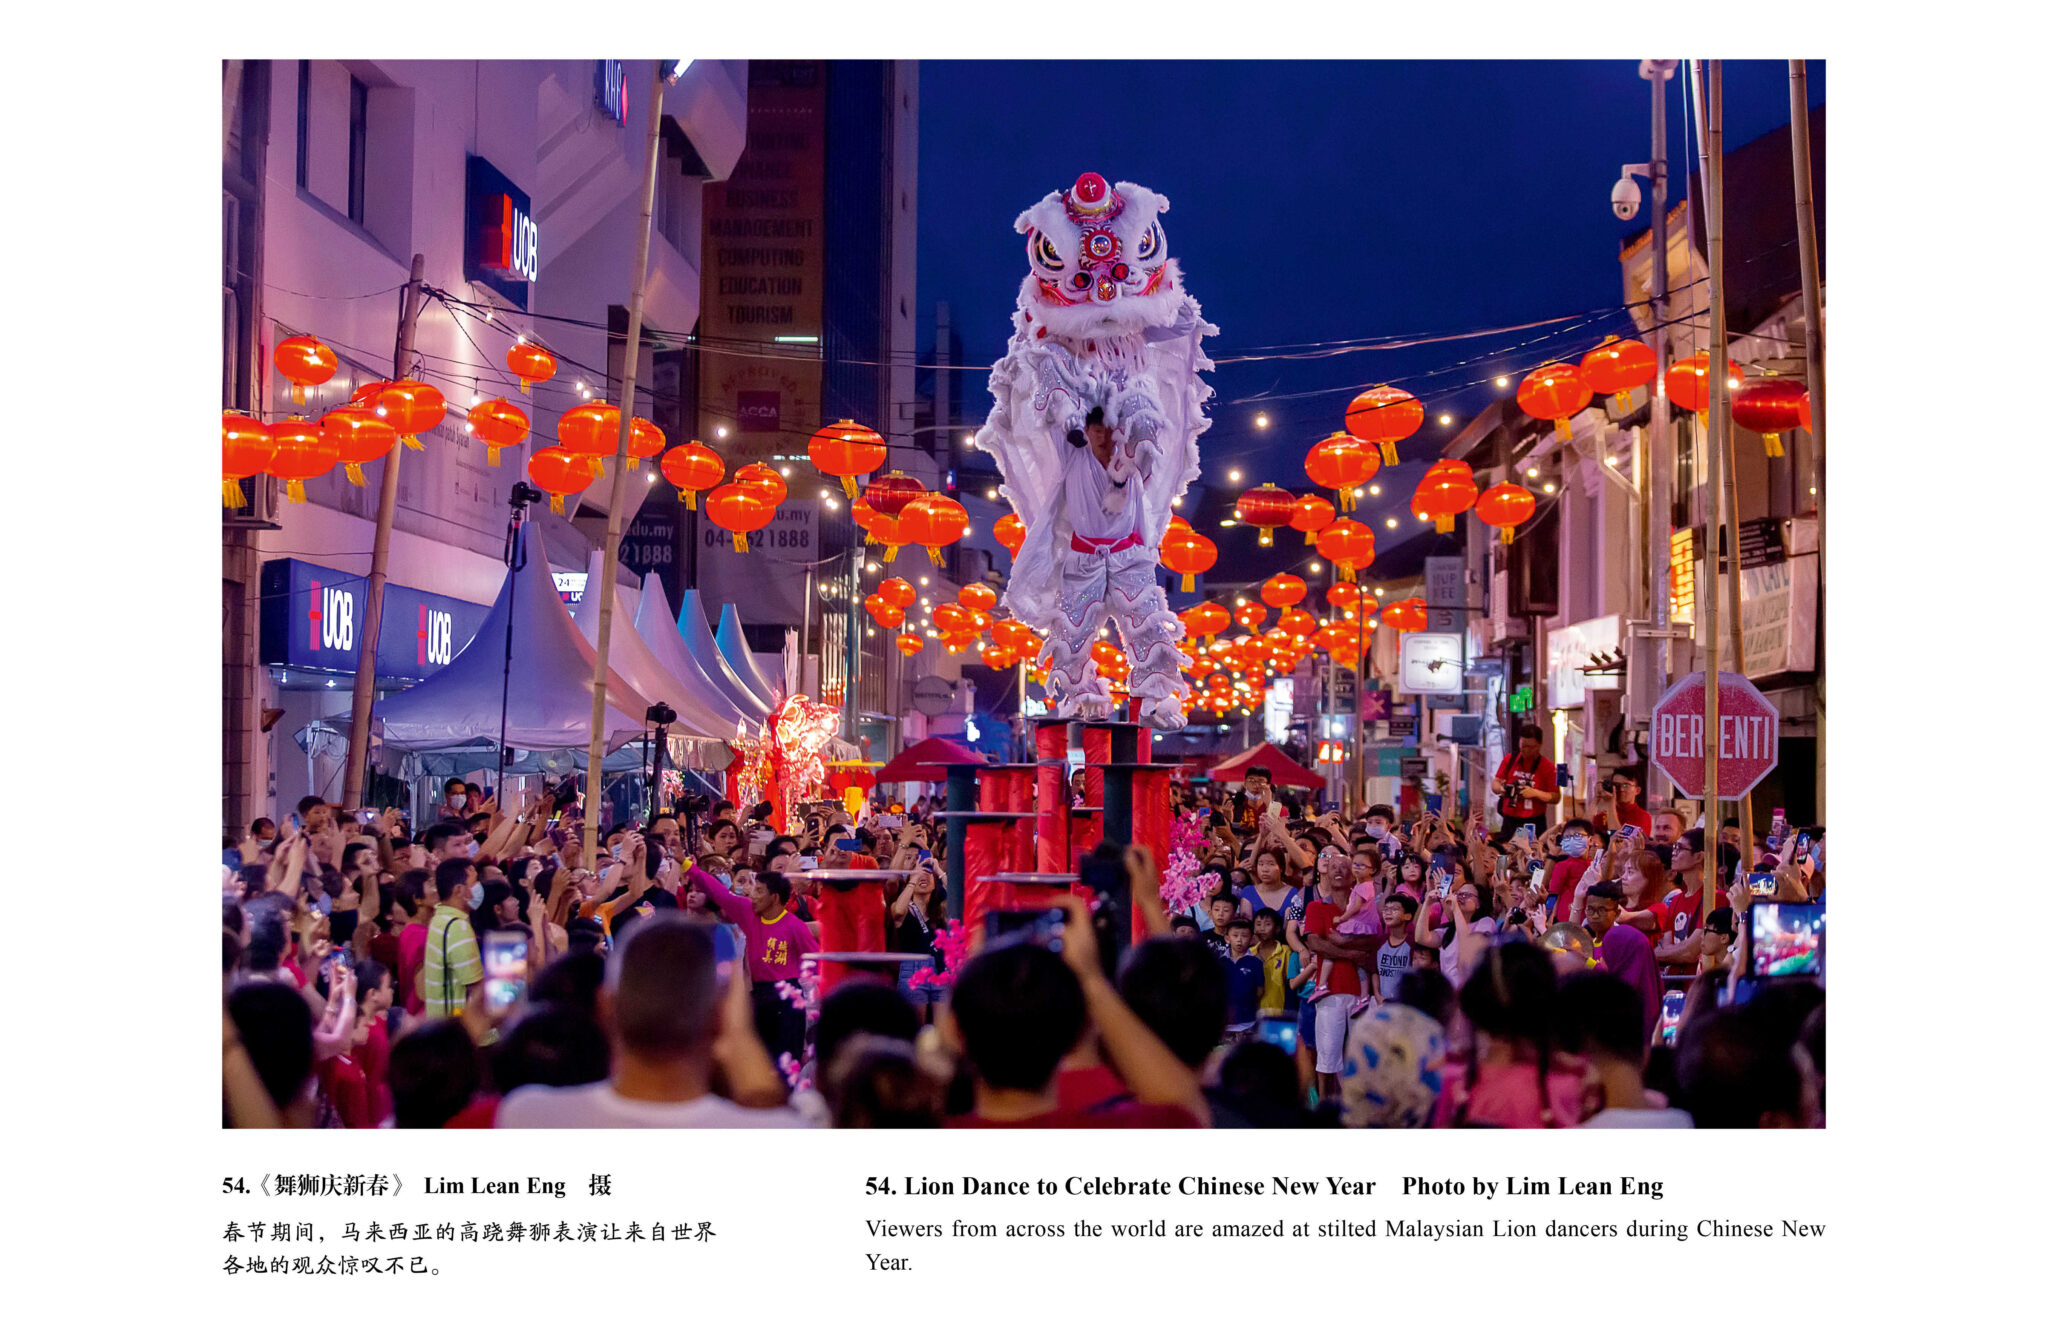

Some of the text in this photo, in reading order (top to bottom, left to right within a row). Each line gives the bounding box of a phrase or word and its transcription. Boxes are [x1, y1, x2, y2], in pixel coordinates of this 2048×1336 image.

[709, 218, 813, 238] MANAGEMENT
[513, 207, 538, 283] UOB
[718, 247, 805, 267] COMPUTING
[719, 277, 802, 296] EDUCATION
[728, 305, 793, 325] TOURISM
[739, 405, 778, 418] ACCA
[323, 587, 353, 651] UOB
[427, 609, 452, 666] UOB
[1660, 713, 1770, 760] BERENTI
[1380, 953, 1409, 967] BEYOND
